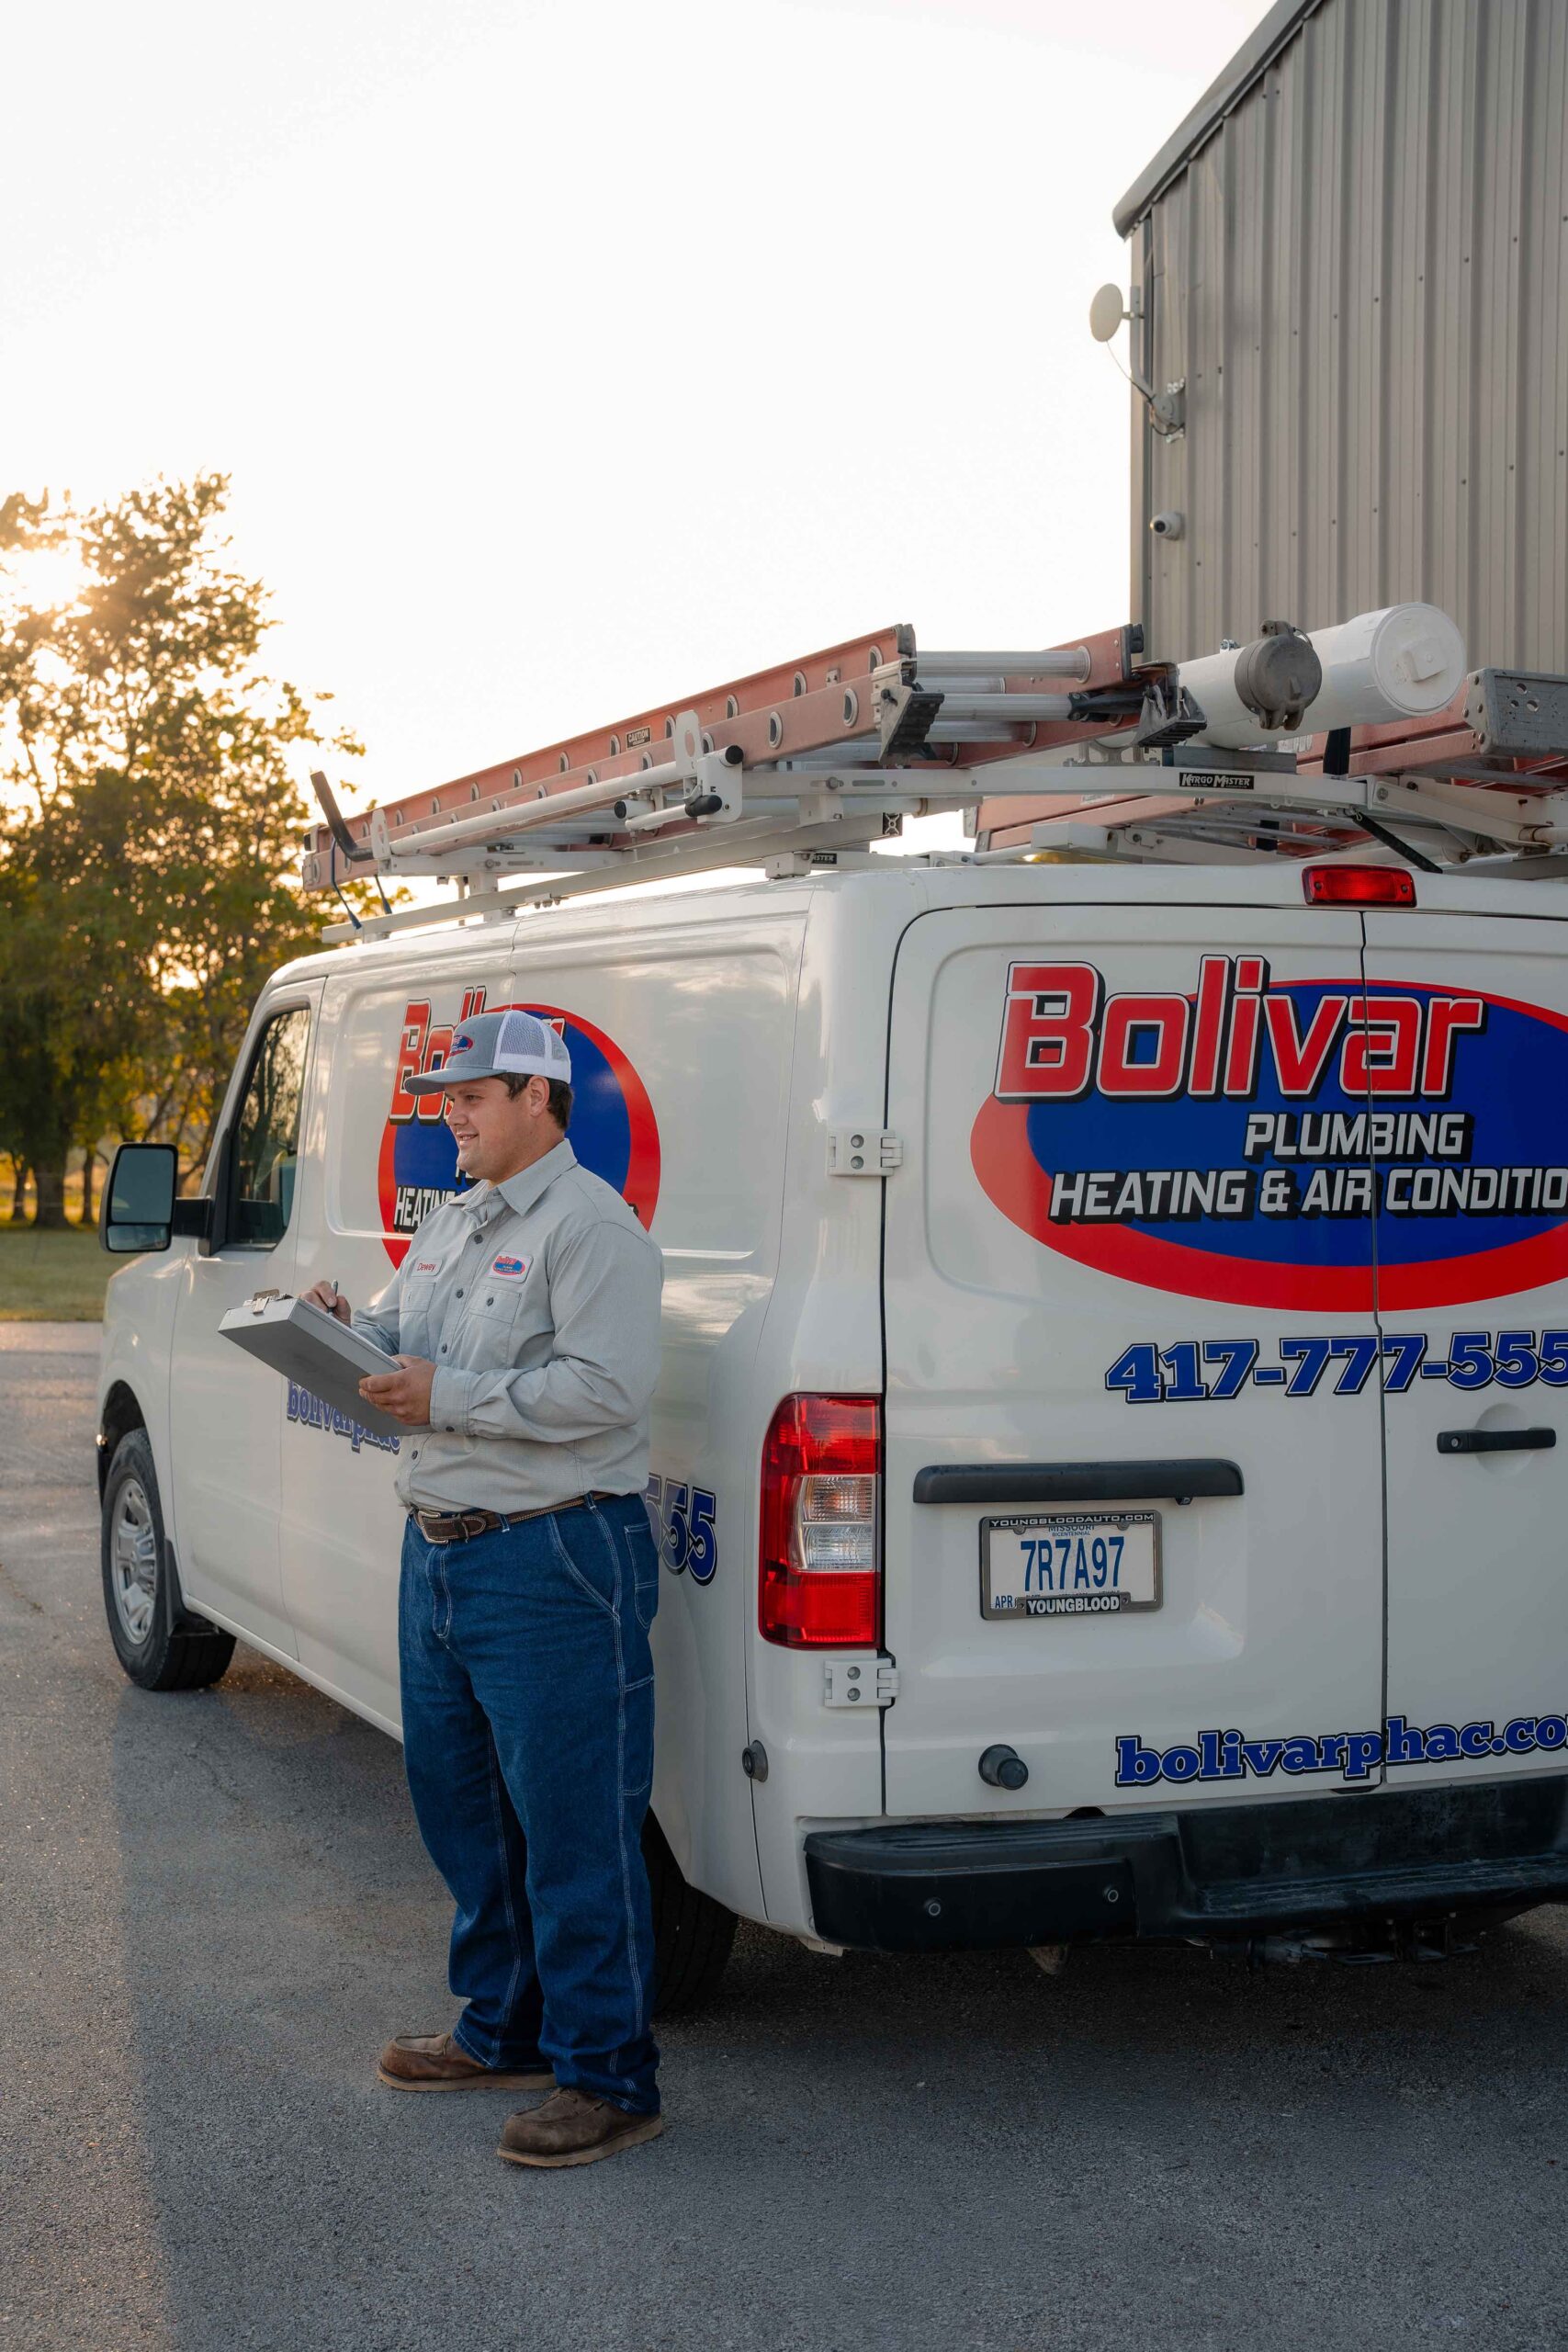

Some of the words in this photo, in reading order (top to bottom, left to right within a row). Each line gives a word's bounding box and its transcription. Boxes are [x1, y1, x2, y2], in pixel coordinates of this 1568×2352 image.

[627, 728, 649, 742] CAUTION
[1181, 774, 1213, 786] KARGO
[1213, 775, 1250, 787] MASTER
[993, 954, 1487, 1104] Bolivar
[1244, 1113, 1472, 1160] PLUMBING
[1049, 1171, 1248, 1221] HEATING
[1259, 1171, 1292, 1216] &
[1302, 1170, 1375, 1216] AIR
[1386, 1168, 1568, 1215] CONDITIO
[417, 1262, 436, 1272] Dewey
[991, 1515, 1154, 1527] YOUNGBLOODAUTO.COM
[1021, 1536, 1124, 1592] 7R7A97
[995, 1595, 1013, 1608] APR
[1026, 1596, 1120, 1614] YOUNGBLOOD
[1114, 1714, 1568, 1787] bolivarphac.co
